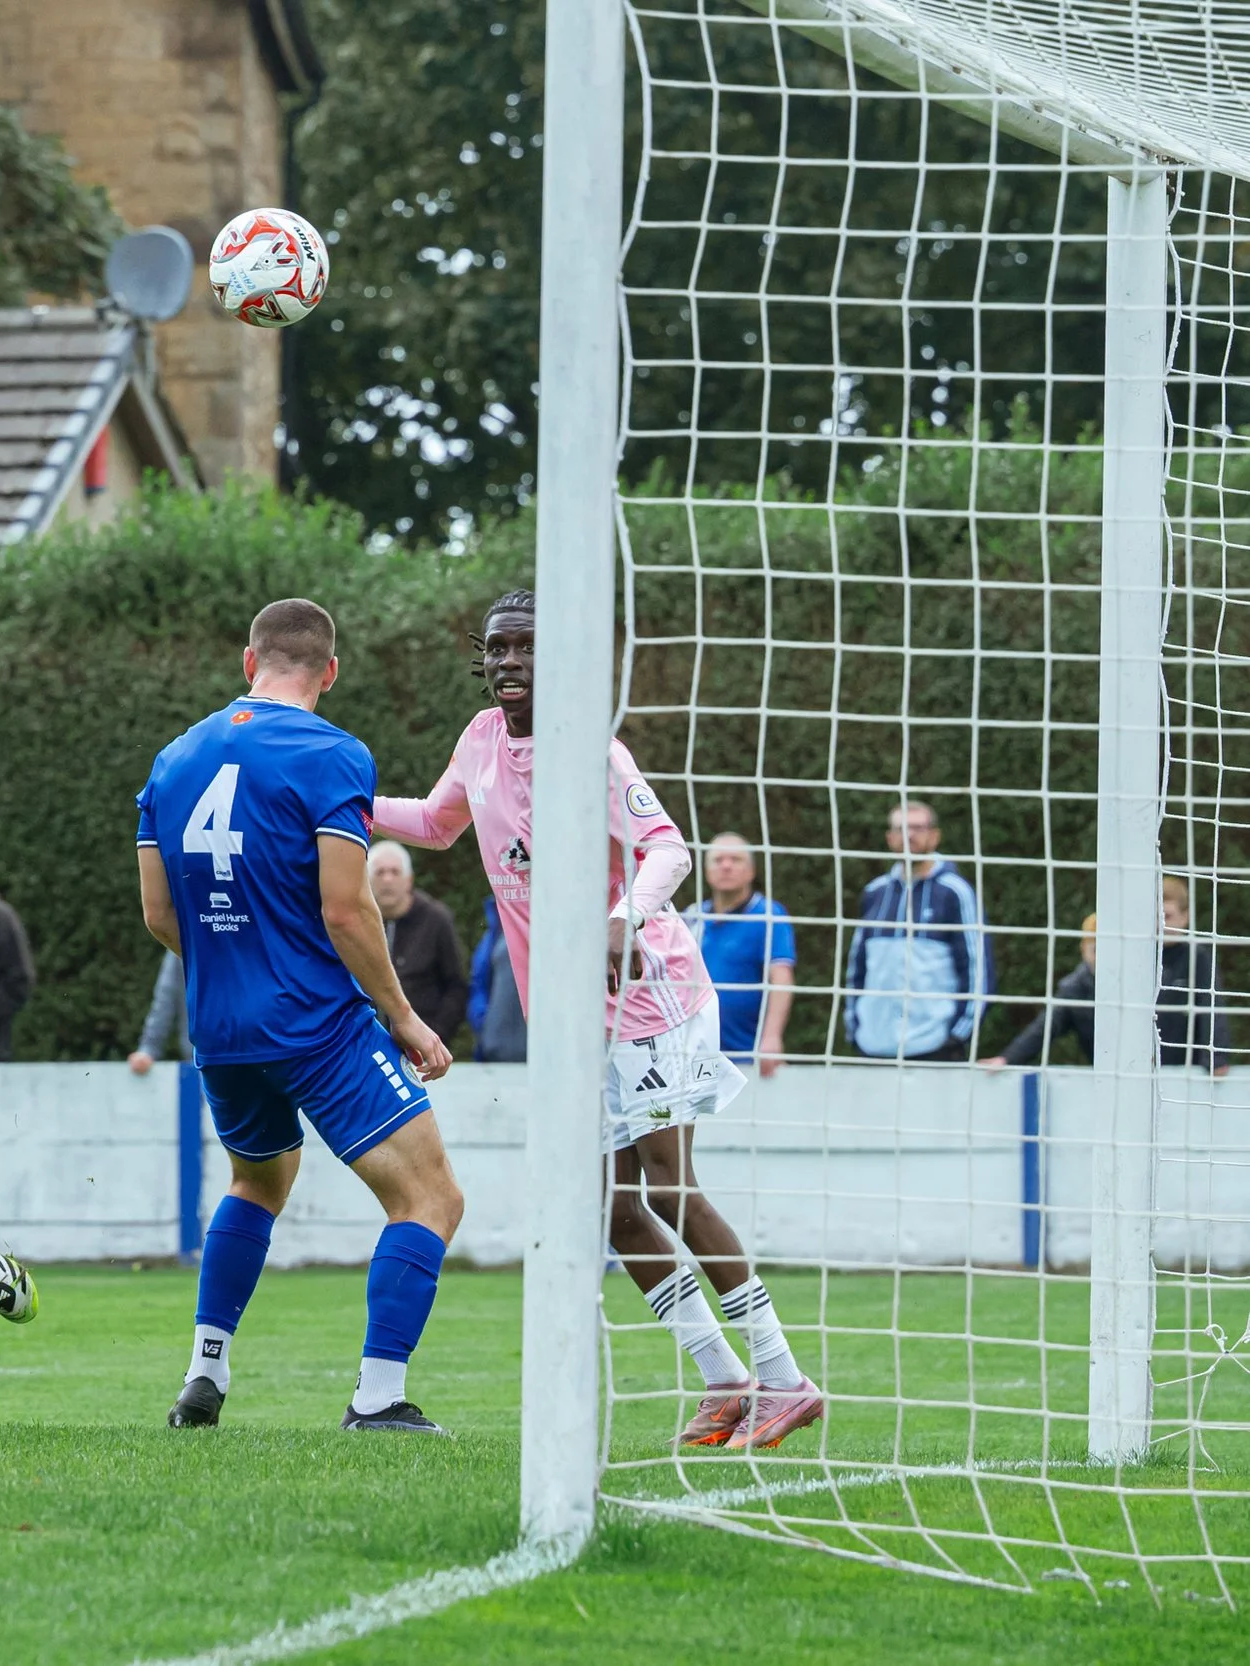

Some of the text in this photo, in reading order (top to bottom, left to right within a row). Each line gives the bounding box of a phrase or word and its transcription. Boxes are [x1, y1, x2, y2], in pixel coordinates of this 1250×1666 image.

[183, 764, 243, 880] 4
[503, 888, 518, 900] UK
[200, 912, 250, 922] Daniel Hurst
[213, 923, 239, 932] Books
